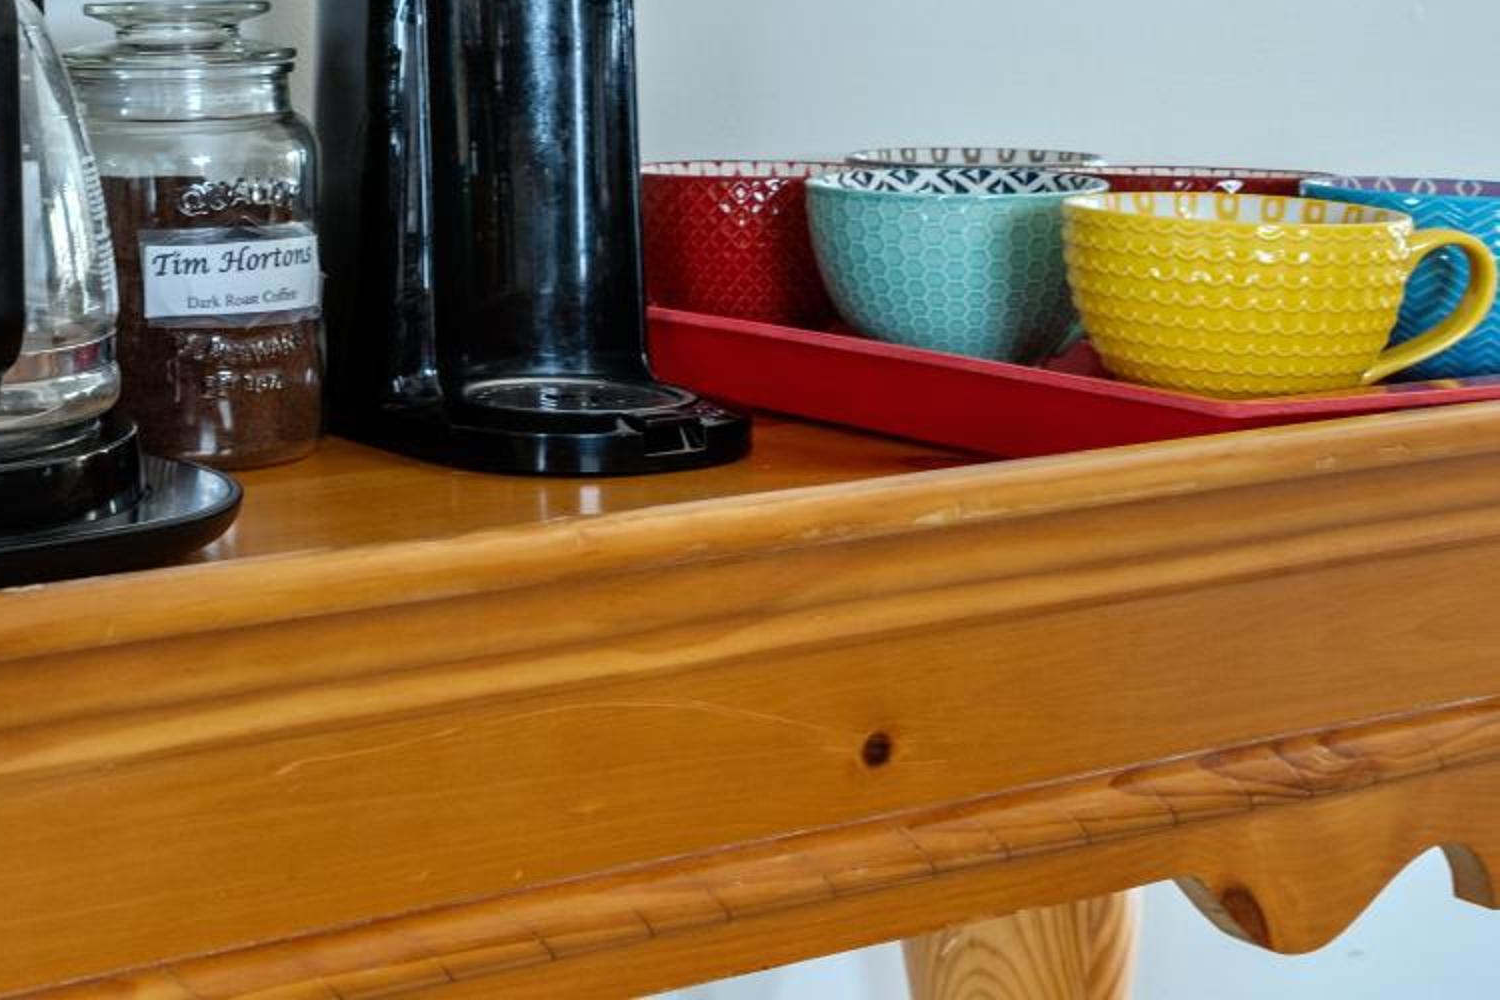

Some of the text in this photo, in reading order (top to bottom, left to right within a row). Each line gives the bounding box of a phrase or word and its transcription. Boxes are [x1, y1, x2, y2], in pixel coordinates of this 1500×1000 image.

[152, 245, 312, 276] Tim Hortons
[187, 295, 221, 309] Dark
